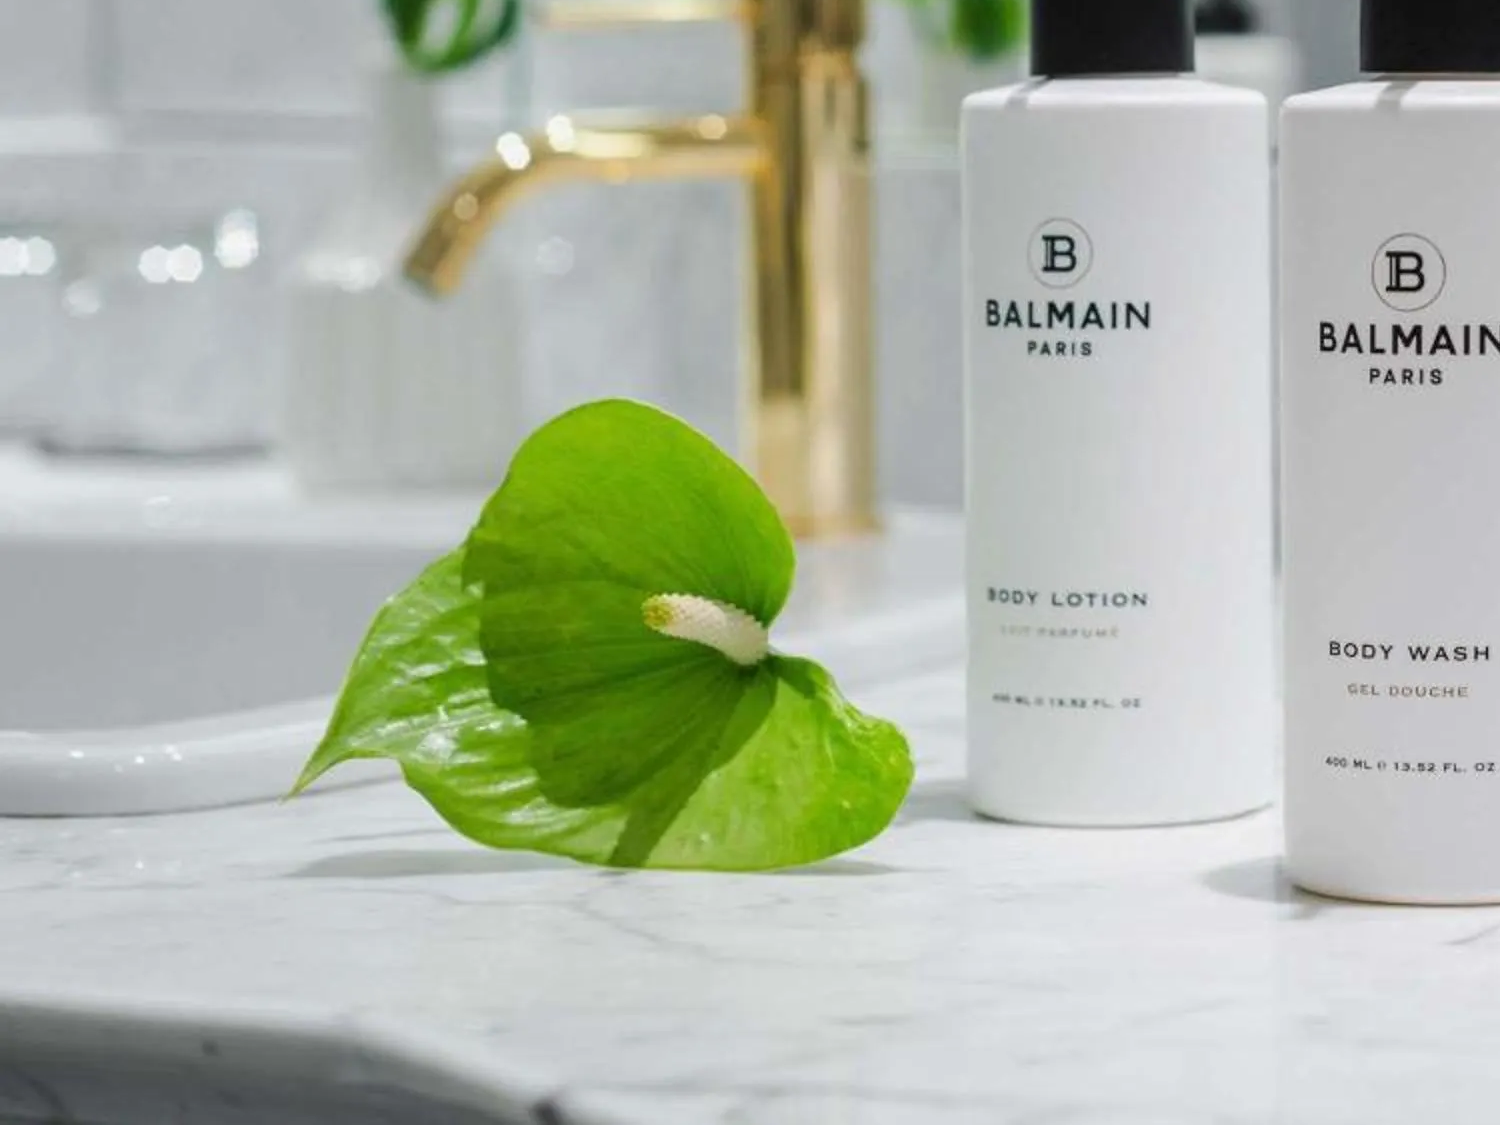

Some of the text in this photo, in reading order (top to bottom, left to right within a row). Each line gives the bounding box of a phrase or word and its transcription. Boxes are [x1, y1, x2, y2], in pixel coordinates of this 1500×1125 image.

[1042, 235, 1077, 272] B
[1385, 251, 1425, 292] B
[986, 299, 1151, 329] BALMAIN
[1028, 341, 1092, 356] PARIS
[1369, 369, 1443, 385] PARIS
[987, 588, 1148, 607] BODY LOTION
[1329, 641, 1491, 662] BODY WASH
[1347, 683, 1469, 698] GEL DOUCHE
[1325, 756, 1347, 768] 400
[1353, 759, 1373, 770] ML
[1393, 762, 1436, 772] 13.52
[1474, 762, 1496, 772] OZ
